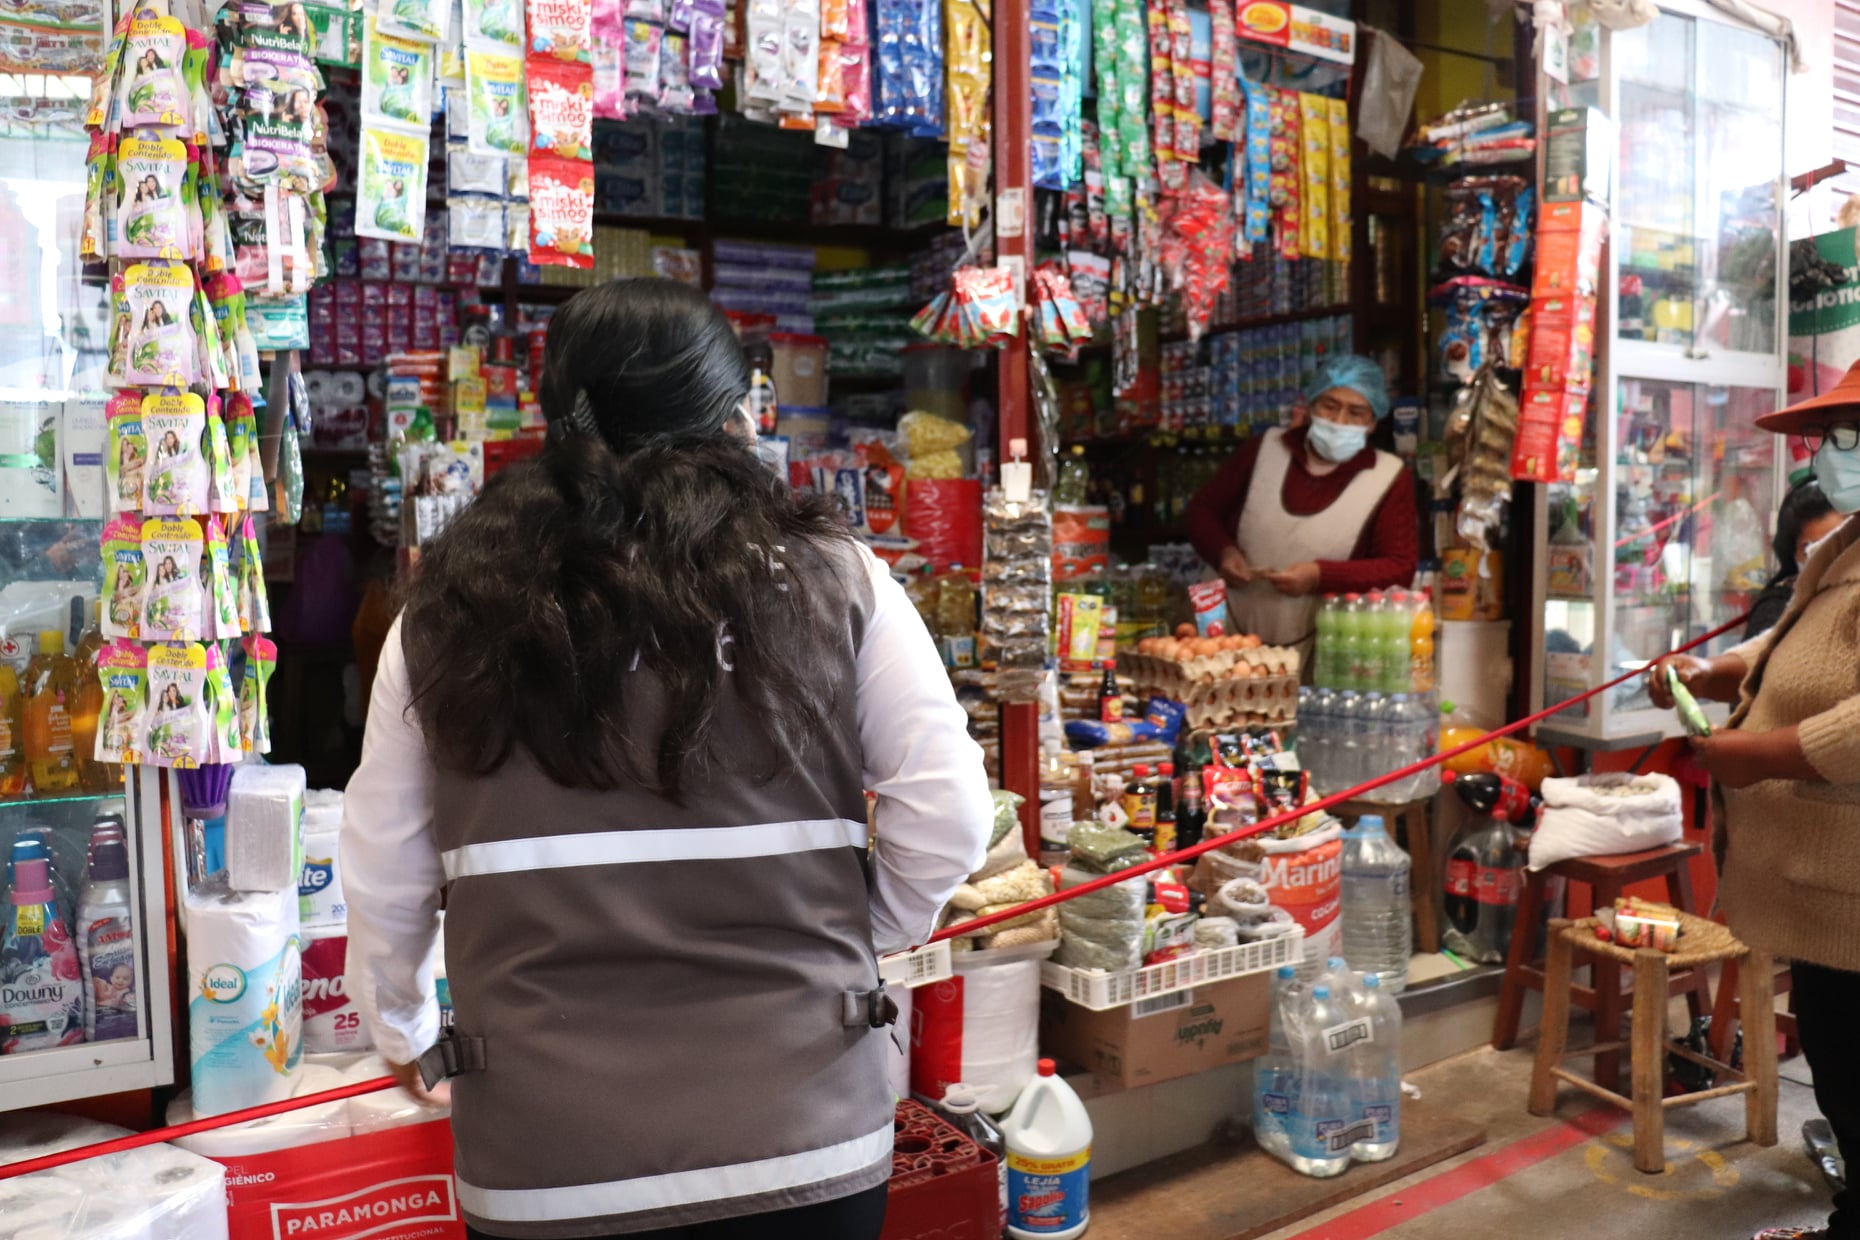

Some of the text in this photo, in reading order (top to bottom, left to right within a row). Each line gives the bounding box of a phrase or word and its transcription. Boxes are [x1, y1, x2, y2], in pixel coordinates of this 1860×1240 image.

[138, 142, 164, 152] Doble
[128, 150, 173, 160] Contenido
[539, 194, 583, 210] miski
[147, 268, 173, 278] Doble
[159, 398, 185, 408] Doble
[150, 406, 192, 415] Contenido
[161, 523, 185, 533] Doble
[151, 531, 193, 541] Contenido
[165, 649, 188, 660] Doble
[210, 978, 237, 990] Ideal
[2, 986, 64, 1004] Downy
[334, 1012, 361, 1031] 25
[9, 1026, 17, 1036] 2
[225, 1165, 249, 1174] PEL
[225, 1172, 276, 1187] GIÉNICO
[287, 1190, 442, 1235] PARAMONGA
